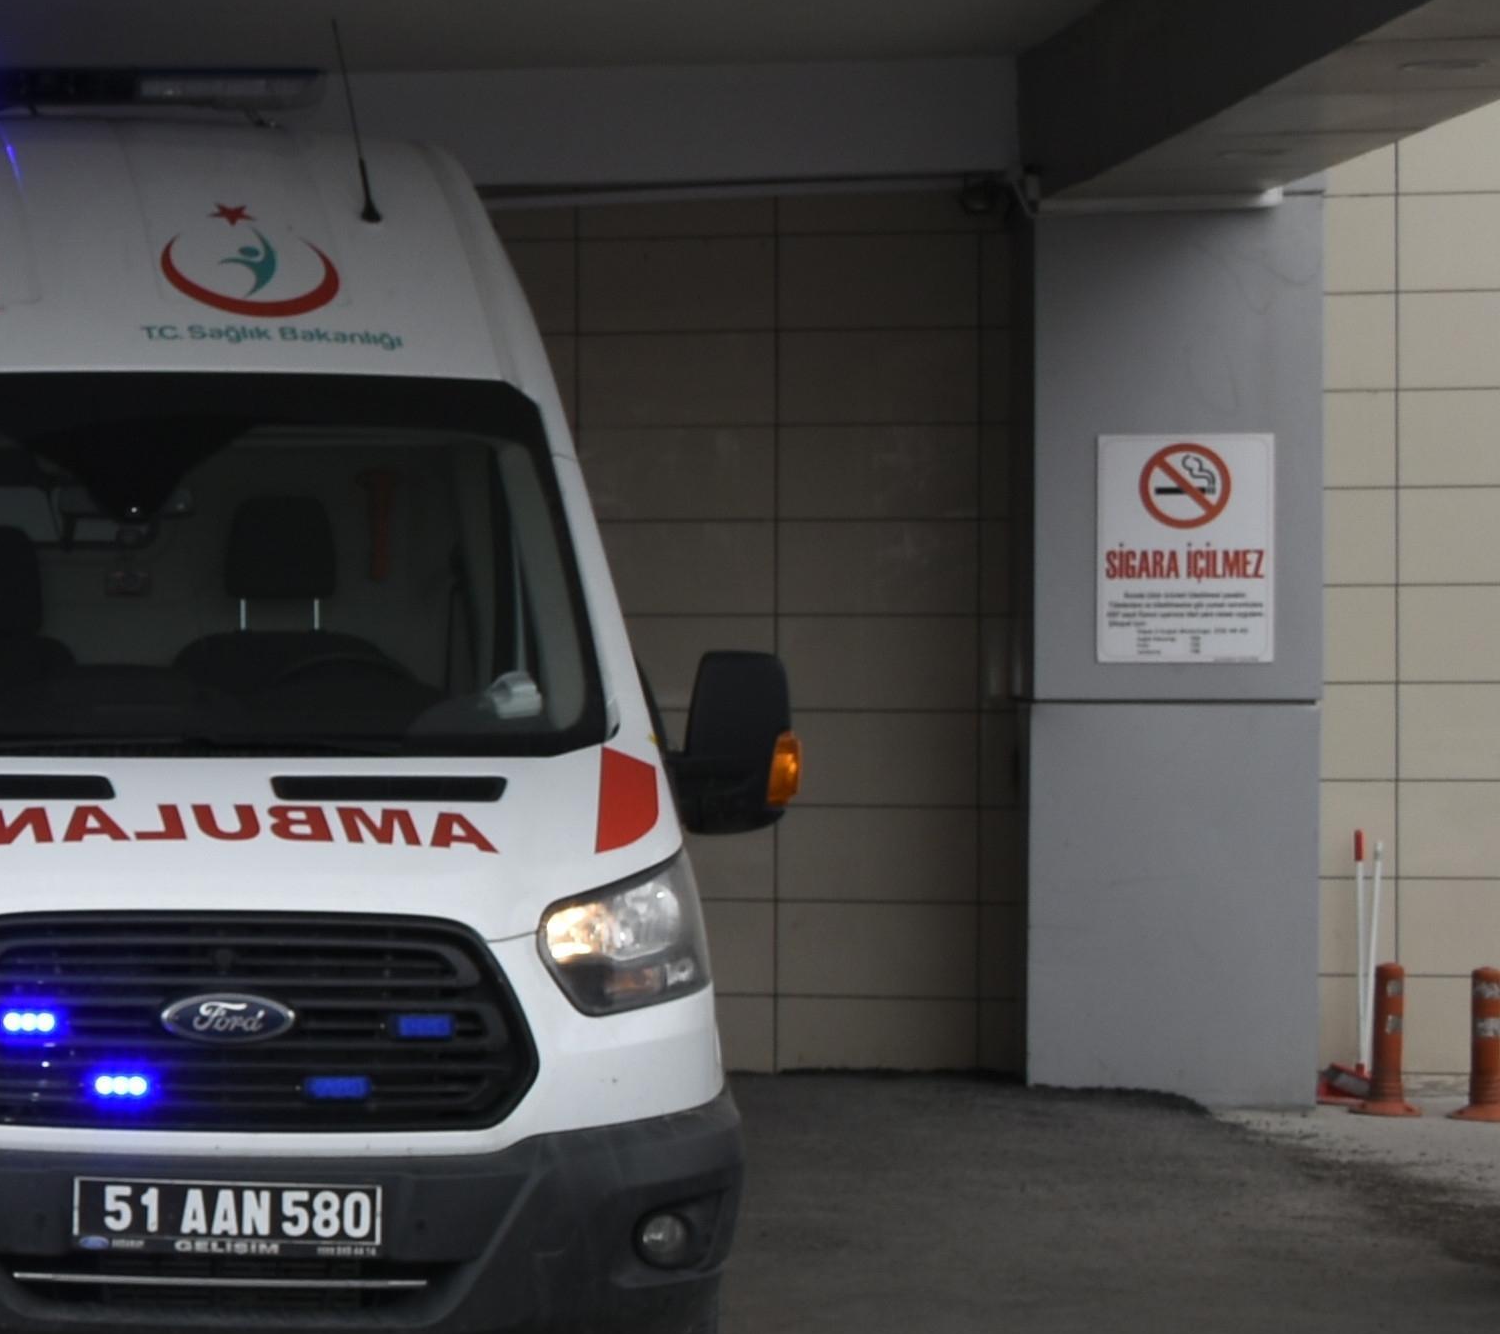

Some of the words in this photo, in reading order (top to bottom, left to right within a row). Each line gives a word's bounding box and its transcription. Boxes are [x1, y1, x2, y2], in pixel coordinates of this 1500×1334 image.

[1105, 542, 1179, 579] SİGARA
[1187, 542, 1265, 583] İÇİLMEZ
[192, 1001, 266, 1031] Ford
[104, 1185, 159, 1232] 51
[181, 1188, 271, 1236] AAN
[281, 1190, 372, 1238] 580
